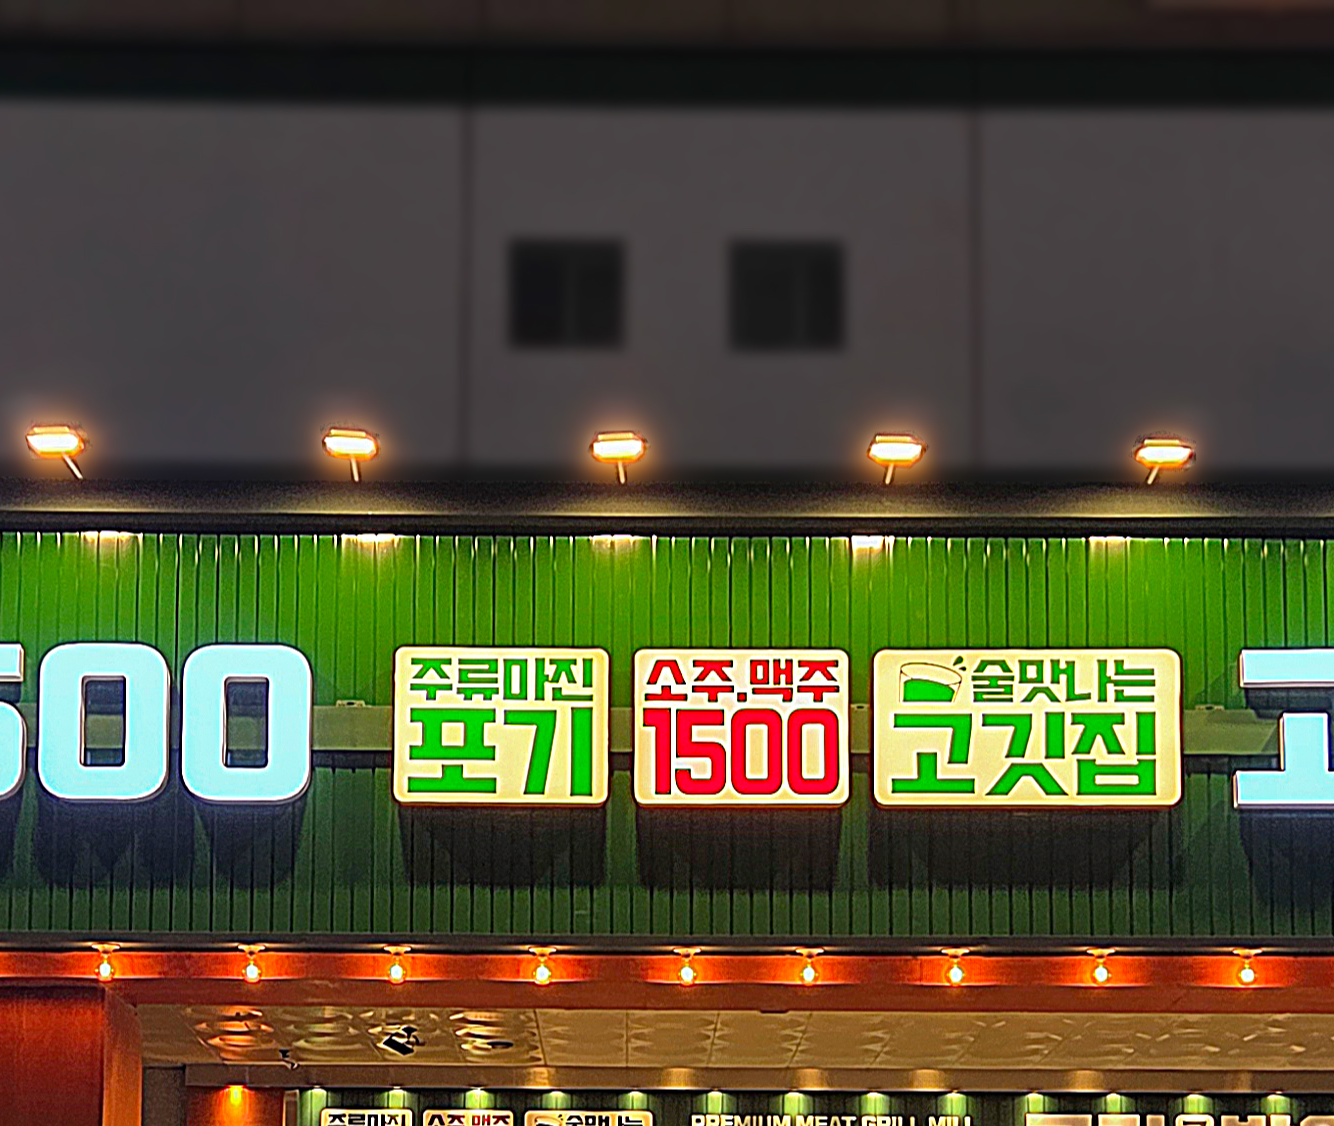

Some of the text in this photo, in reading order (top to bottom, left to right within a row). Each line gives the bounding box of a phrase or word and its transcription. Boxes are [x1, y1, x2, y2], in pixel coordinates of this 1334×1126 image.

[409, 656, 594, 703] 주류마진
[644, 658, 841, 704] 소주.맥주
[970, 657, 1156, 704] 술맛나는
[406, 707, 593, 797] 포기
[642, 707, 841, 796] 1500
[890, 711, 1156, 796] 고깃집
